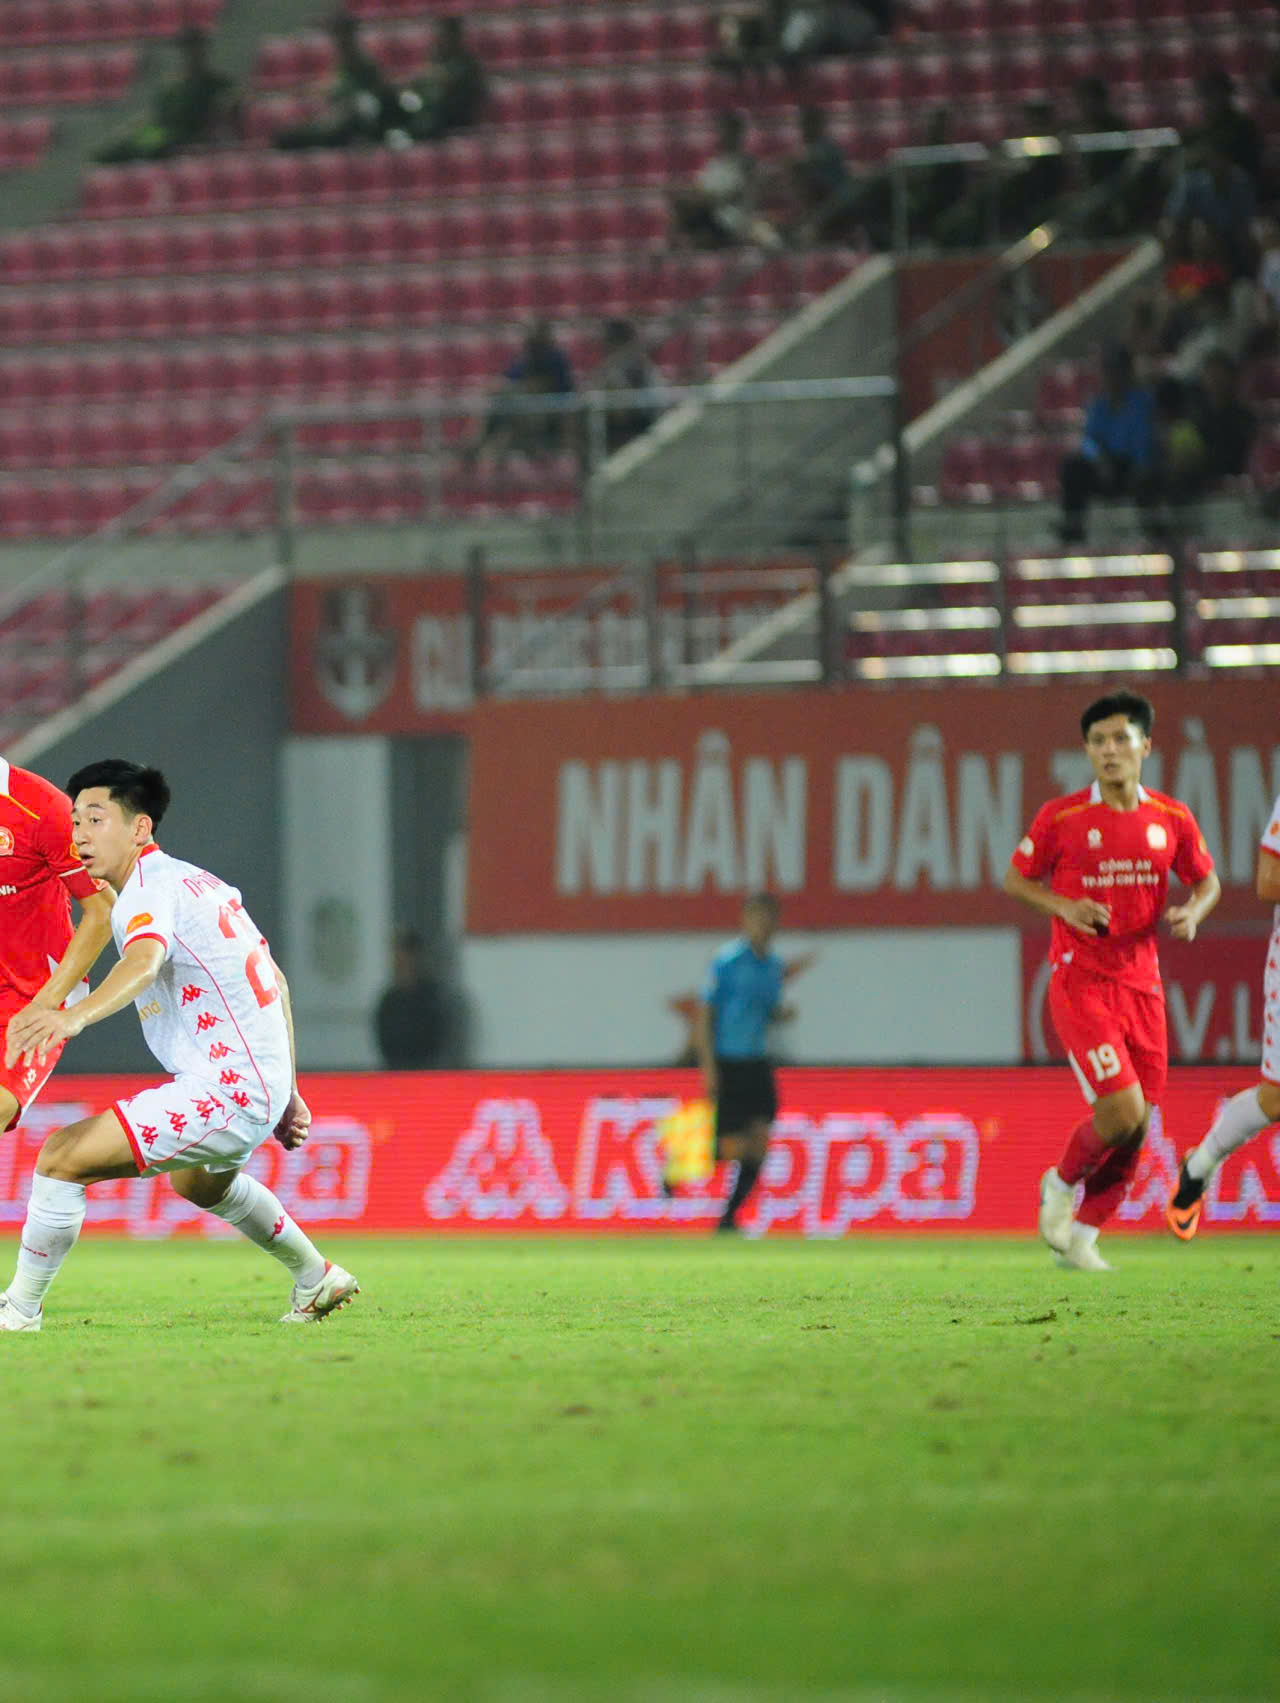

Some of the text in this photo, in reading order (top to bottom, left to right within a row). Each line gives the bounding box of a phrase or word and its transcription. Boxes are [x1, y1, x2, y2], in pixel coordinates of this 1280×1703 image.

[556, 728, 808, 893] NHÂN
[833, 722, 1023, 892] DÂN
[1087, 1042, 1122, 1082] 19
[572, 1097, 981, 1241] Kppa
